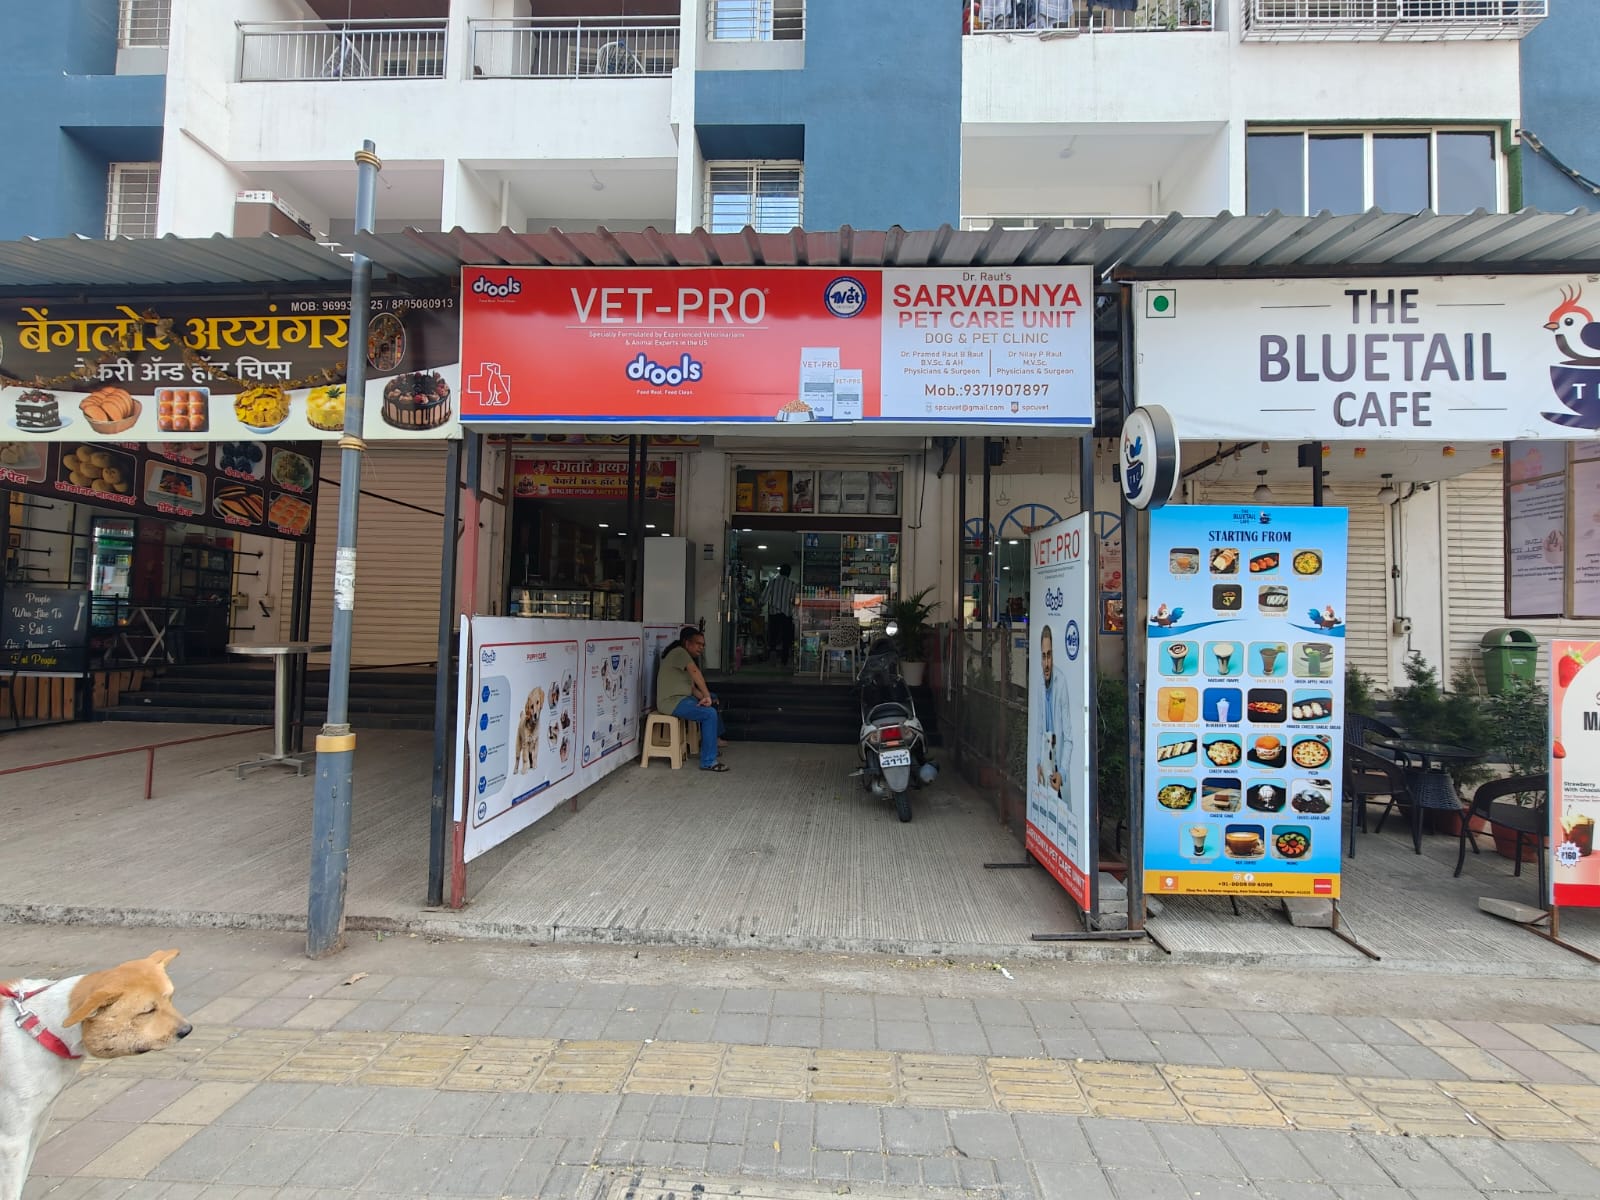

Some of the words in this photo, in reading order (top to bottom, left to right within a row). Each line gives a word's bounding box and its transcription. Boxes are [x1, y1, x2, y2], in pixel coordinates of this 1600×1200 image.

[962, 272, 977, 281] Dr.
[980, 272, 1012, 281] Raut's
[473, 275, 520, 297] drools
[893, 284, 1082, 307] SARVADNYA
[291, 301, 319, 312] MOB:
[1343, 288, 1419, 324] THE
[899, 311, 943, 328] PET
[949, 311, 1013, 328] CARE
[1022, 311, 1076, 328] UNIT
[925, 333, 953, 344] DOG
[958, 333, 967, 344] &
[972, 333, 999, 344] PET
[1002, 333, 1049, 344] CLINIC
[1260, 332, 1507, 382] BLUETAIL
[627, 353, 702, 386] drools
[1333, 391, 1432, 427] CAFE
[1208, 530, 1258, 542] STARTING
[1261, 531, 1292, 543] FROM
[1033, 529, 1080, 566] VET-PRO
[25, 592, 51, 605] People
[12, 607, 32, 618] Who
[33, 607, 49, 620] Like
[51, 607, 63, 619] To
[28, 622, 44, 635] Eat
[31, 653, 57, 666] People
[1584, 711, 1600, 731] M
